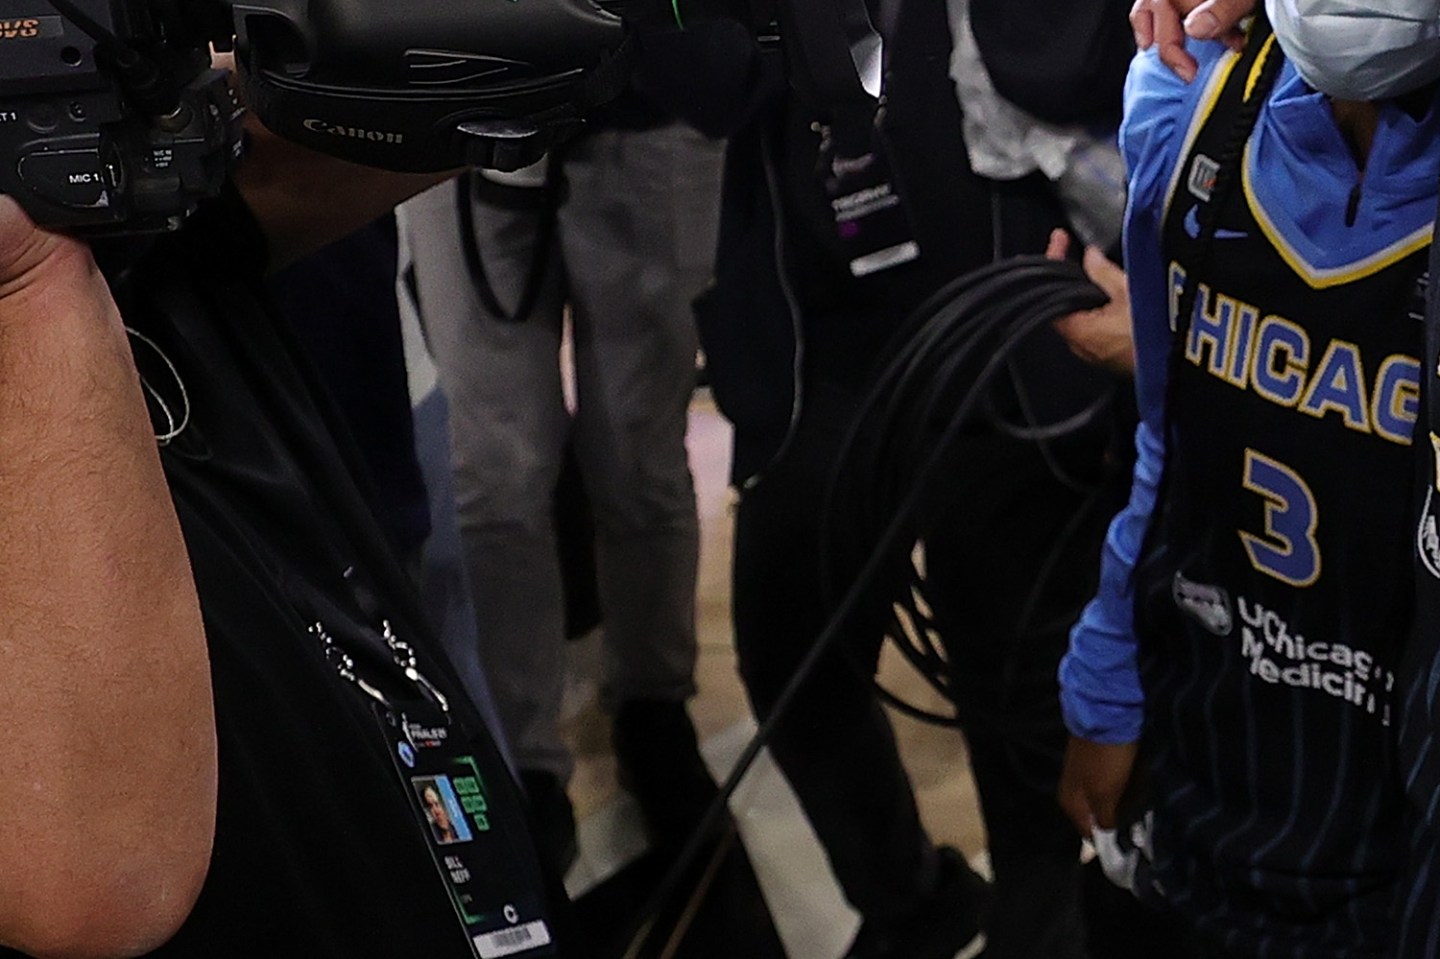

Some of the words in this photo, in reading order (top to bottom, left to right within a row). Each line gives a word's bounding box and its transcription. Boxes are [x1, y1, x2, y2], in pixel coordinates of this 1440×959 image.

[302, 118, 404, 144] Canon
[69, 173, 90, 184] MIC
[1237, 446, 1322, 589] 3
